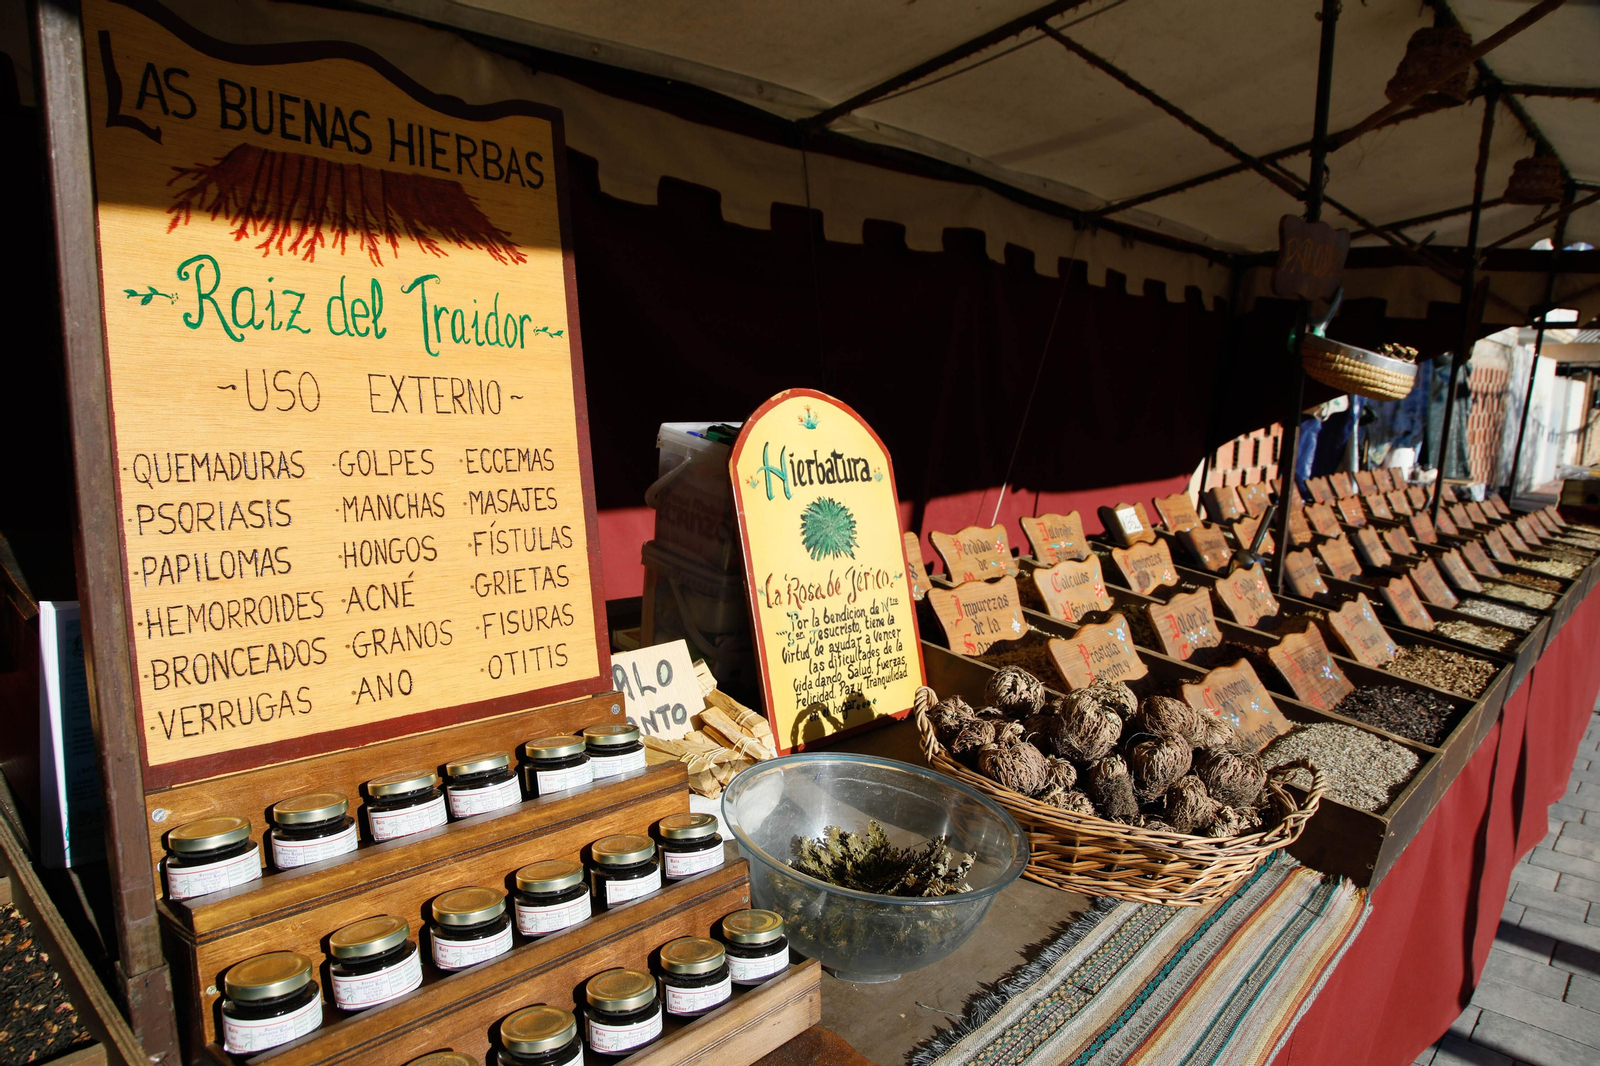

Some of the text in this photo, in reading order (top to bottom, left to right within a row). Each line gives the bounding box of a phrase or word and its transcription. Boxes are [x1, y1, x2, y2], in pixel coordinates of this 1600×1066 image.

[98, 30, 545, 190] LAS BUENAS HIERBAS
[176, 254, 532, 358] Raiz del Traidor
[132, 450, 305, 490] QUEMADURAS
[338, 449, 435, 477] GOLPES
[465, 447, 555, 474] ECCEMAS
[756, 441, 873, 501] Hierbatura
[136, 499, 293, 536] PSORIASIS
[342, 492, 446, 523] MANCHAS
[468, 487, 559, 515] MASAJES
[342, 535, 438, 569] HONGOS
[472, 521, 573, 557] FÍSTULAS
[141, 546, 293, 587] PAPILOMAS
[474, 564, 571, 598] GRIETAS
[975, 557, 988, 571] de
[346, 572, 415, 614] ACNÉ
[766, 572, 783, 608] La
[784, 573, 826, 611] Rosa
[146, 591, 325, 640] HEMORROIDES
[482, 603, 575, 639] FISURAS
[786, 611, 809, 632] Por
[812, 608, 820, 627] la
[823, 604, 866, 625] bendicion
[870, 598, 880, 615] de
[865, 616, 885, 630] tiene
[887, 613, 895, 625] la
[971, 616, 1001, 635] de la
[351, 620, 454, 659] GRANOS
[809, 638, 903, 675] las dificultades de la
[815, 640, 824, 657] de
[828, 634, 862, 653] ayudar
[865, 634, 871, 645] a
[151, 637, 328, 691] BRONCEADOS
[487, 643, 568, 680] OTITIS
[355, 669, 414, 705] ANO
[815, 672, 842, 688] dando
[839, 680, 855, 697] Paz
[857, 682, 863, 698] y
[863, 663, 908, 690] Tranquilidad
[158, 686, 313, 740] VERRUGAS
[809, 709, 820, 722] en
[823, 702, 830, 717] el
